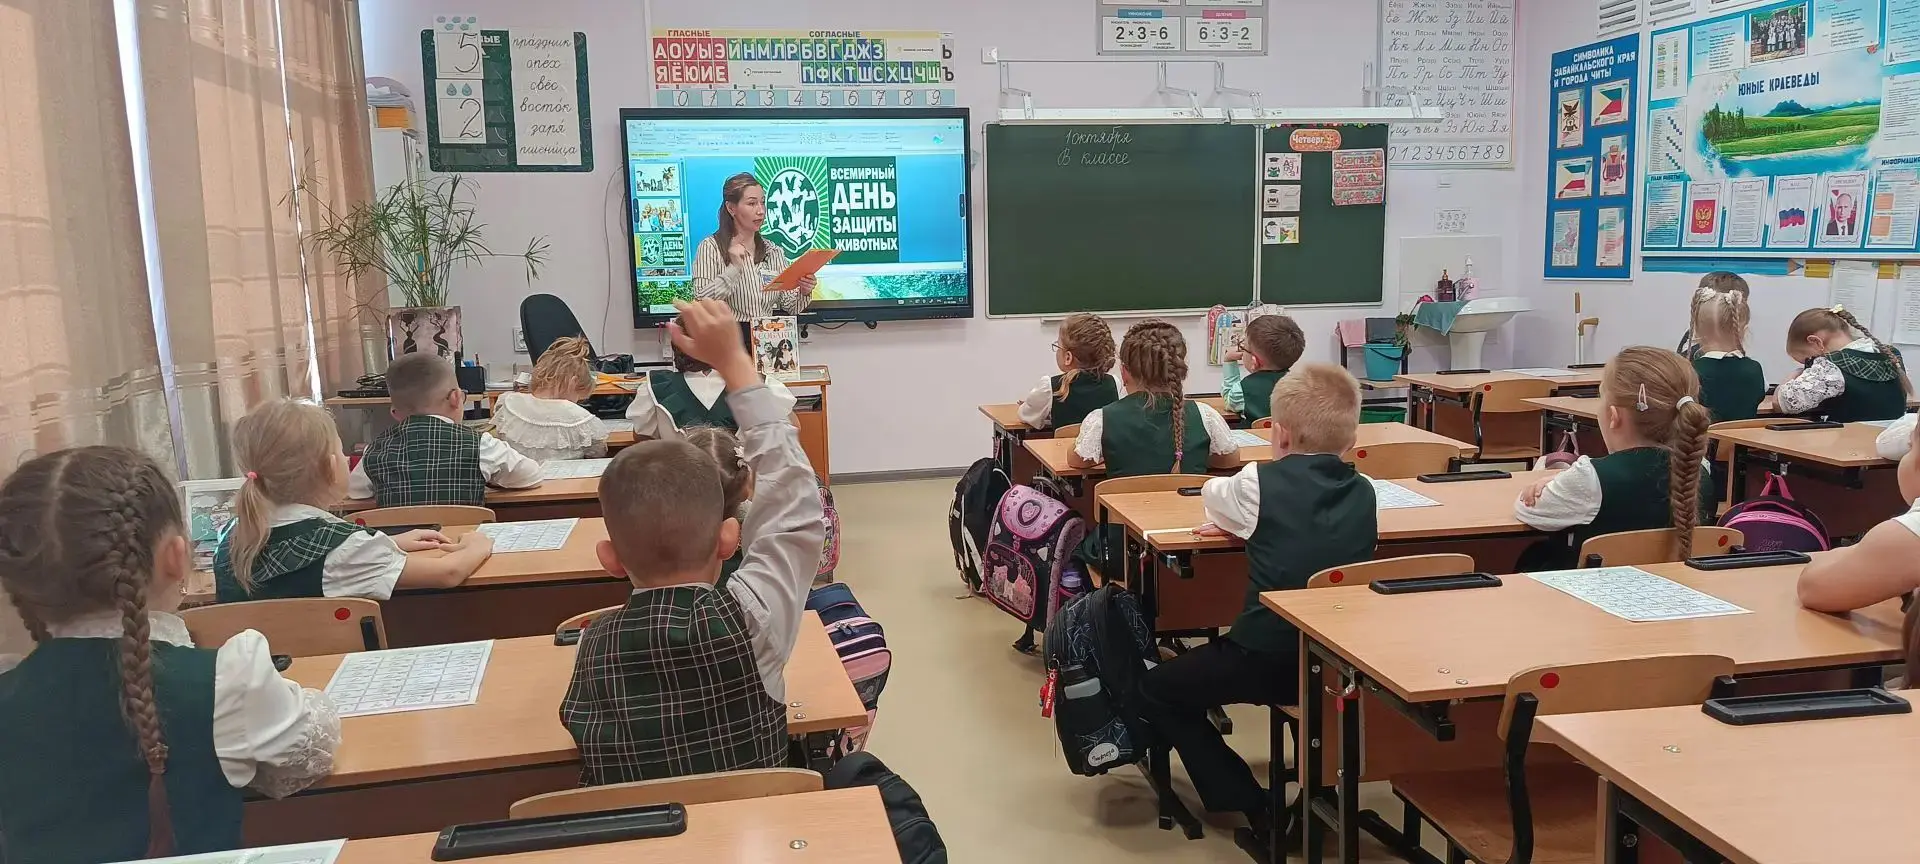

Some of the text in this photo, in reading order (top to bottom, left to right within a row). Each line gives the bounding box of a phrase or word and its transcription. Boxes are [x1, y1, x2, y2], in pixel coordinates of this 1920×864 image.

[667, 29, 711, 37] ГЛАСНЫЕ
[809, 30, 861, 38] СОГЛАСНЫЕ
[1116, 26, 1125, 40] 2
[1137, 26, 1147, 40] 3
[1159, 26, 1168, 40] 6
[1199, 26, 1208, 40] 6
[1220, 26, 1229, 40] 3
[1240, 26, 1249, 40] 2
[454, 32, 480, 73] 5
[1573, 45, 1614, 62] СИМВОЛИКА
[1554, 52, 1636, 77] ЗАБАЙКАЛЬСКОГО КРАЯ
[1553, 68, 1612, 88] И ГОРОДА ЧИТЫ
[1738, 71, 1820, 96] ЮНЫЕ КРАЕВЕДЫ
[735, 90, 747, 106] 2
[763, 90, 775, 106] 3
[793, 90, 803, 105] 4
[819, 90, 830, 106] 5
[848, 90, 859, 105] 6
[875, 90, 886, 106] 7
[903, 90, 914, 105] 8
[930, 90, 941, 105] 9
[459, 98, 483, 138] 2
[1057, 147, 1130, 166] В классе
[830, 164, 895, 180] ВСЕМИРНЫЙ
[831, 182, 896, 216] ДЕНЬ
[832, 216, 897, 236] ЗАЩИТЫ
[663, 241, 684, 250] ДЕНЬ
[834, 237, 899, 251] ЖИВОТНЫХ
